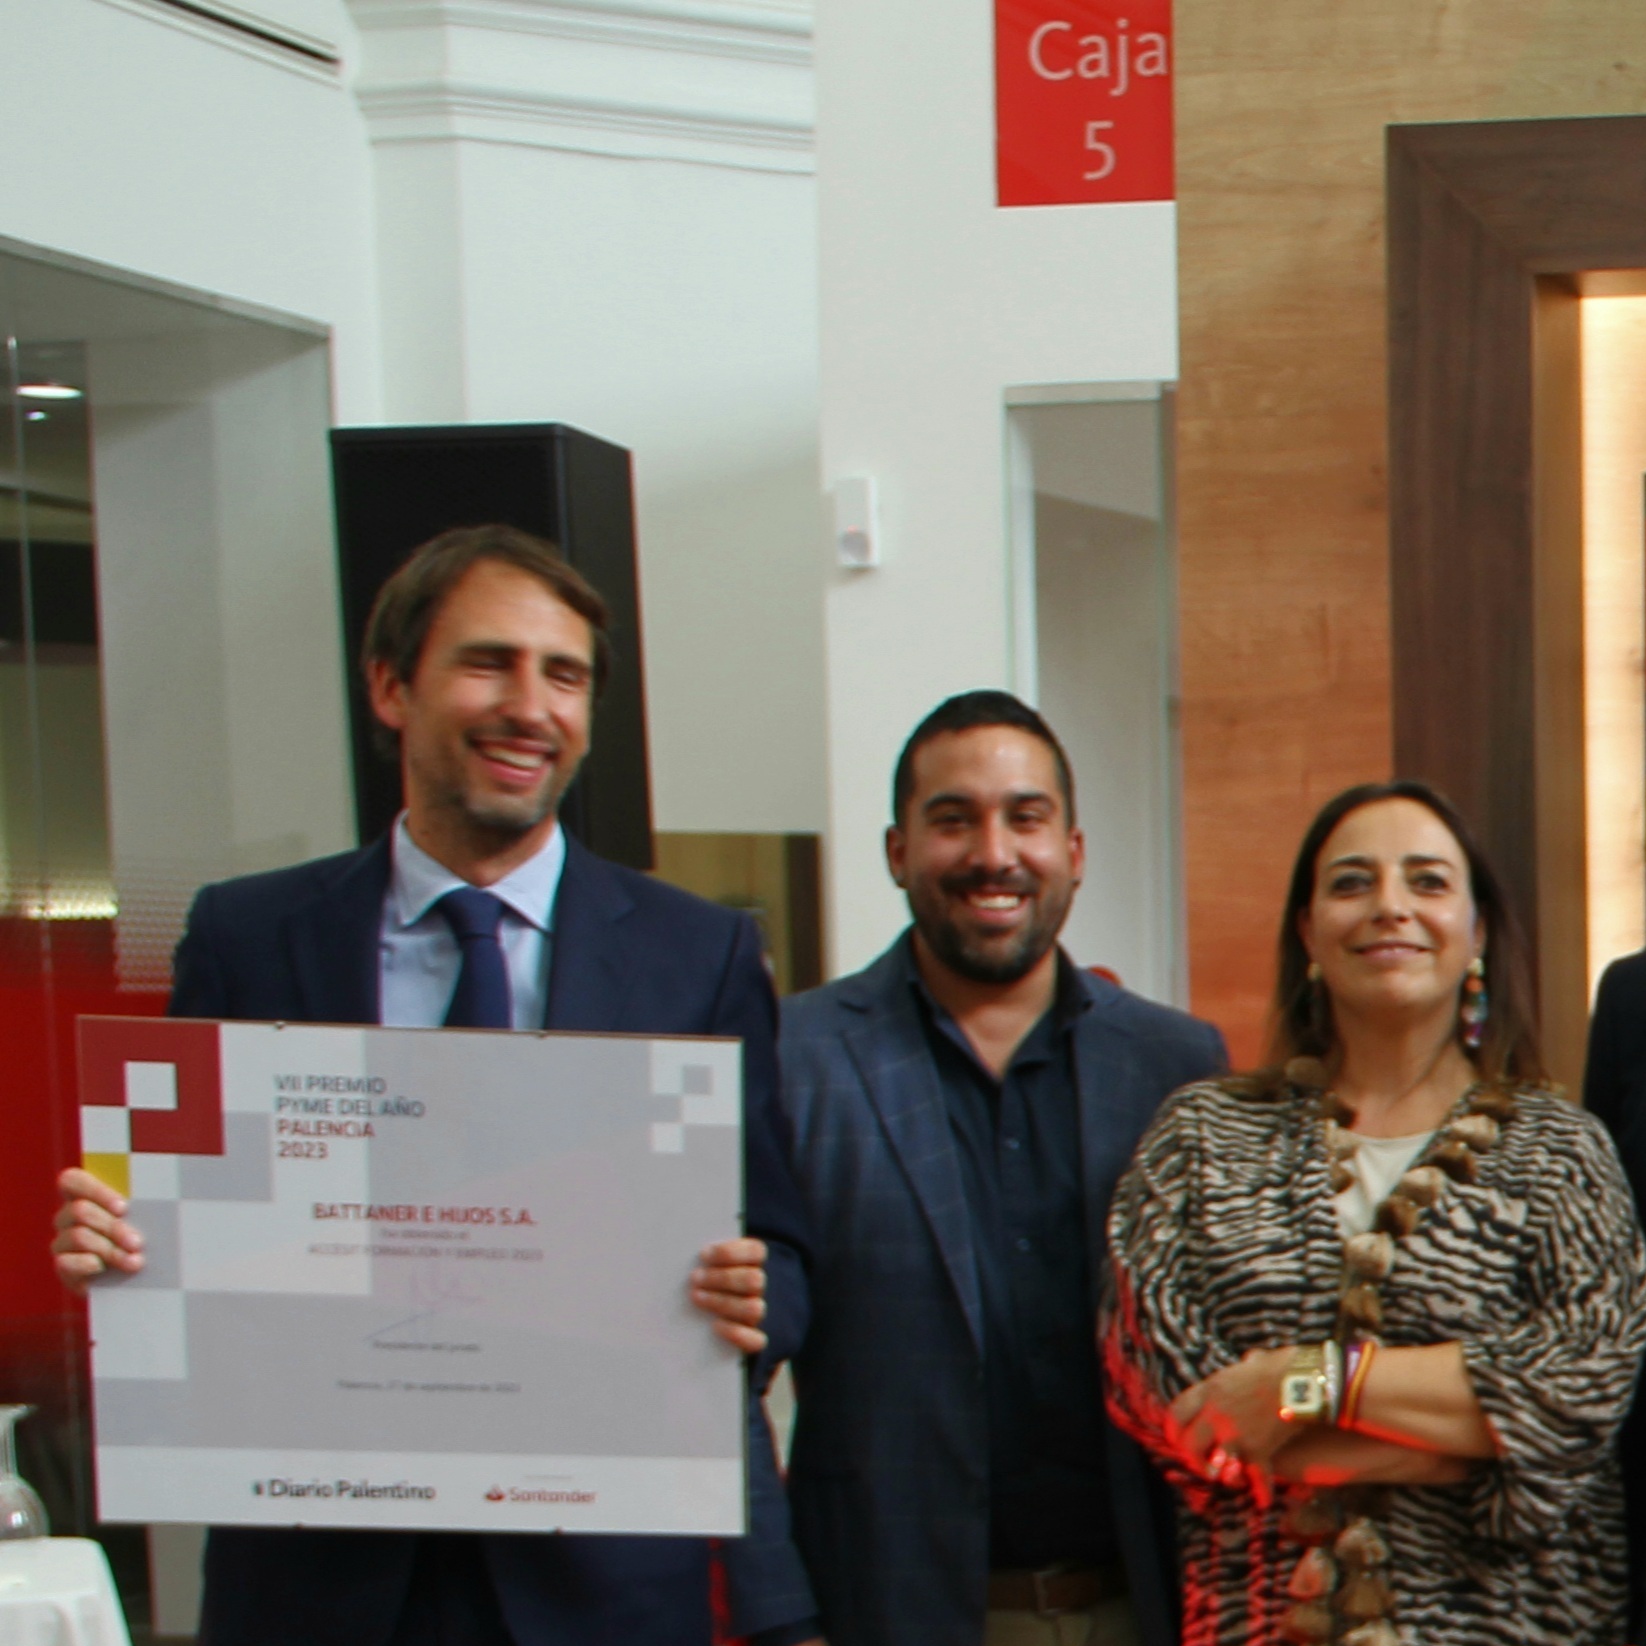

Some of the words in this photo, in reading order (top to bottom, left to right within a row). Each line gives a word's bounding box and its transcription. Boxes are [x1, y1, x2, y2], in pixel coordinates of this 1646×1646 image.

[1029, 18, 1167, 96] Caja
[1083, 121, 1116, 180] 5
[275, 1075, 301, 1090] VII
[306, 1075, 387, 1094] PREMIO
[276, 1096, 333, 1114] PYME
[338, 1098, 376, 1115] DEL
[382, 1096, 426, 1117] AÑO
[278, 1119, 376, 1137] PALENCIA
[278, 1141, 329, 1158] 2023
[313, 1203, 418, 1221] BATTANER
[422, 1205, 434, 1222] E
[439, 1206, 496, 1224] HIJOS
[500, 1207, 537, 1226] S.A.
[269, 1478, 333, 1497] Diario
[336, 1480, 436, 1500] Palentino
[510, 1488, 596, 1504] Santander
